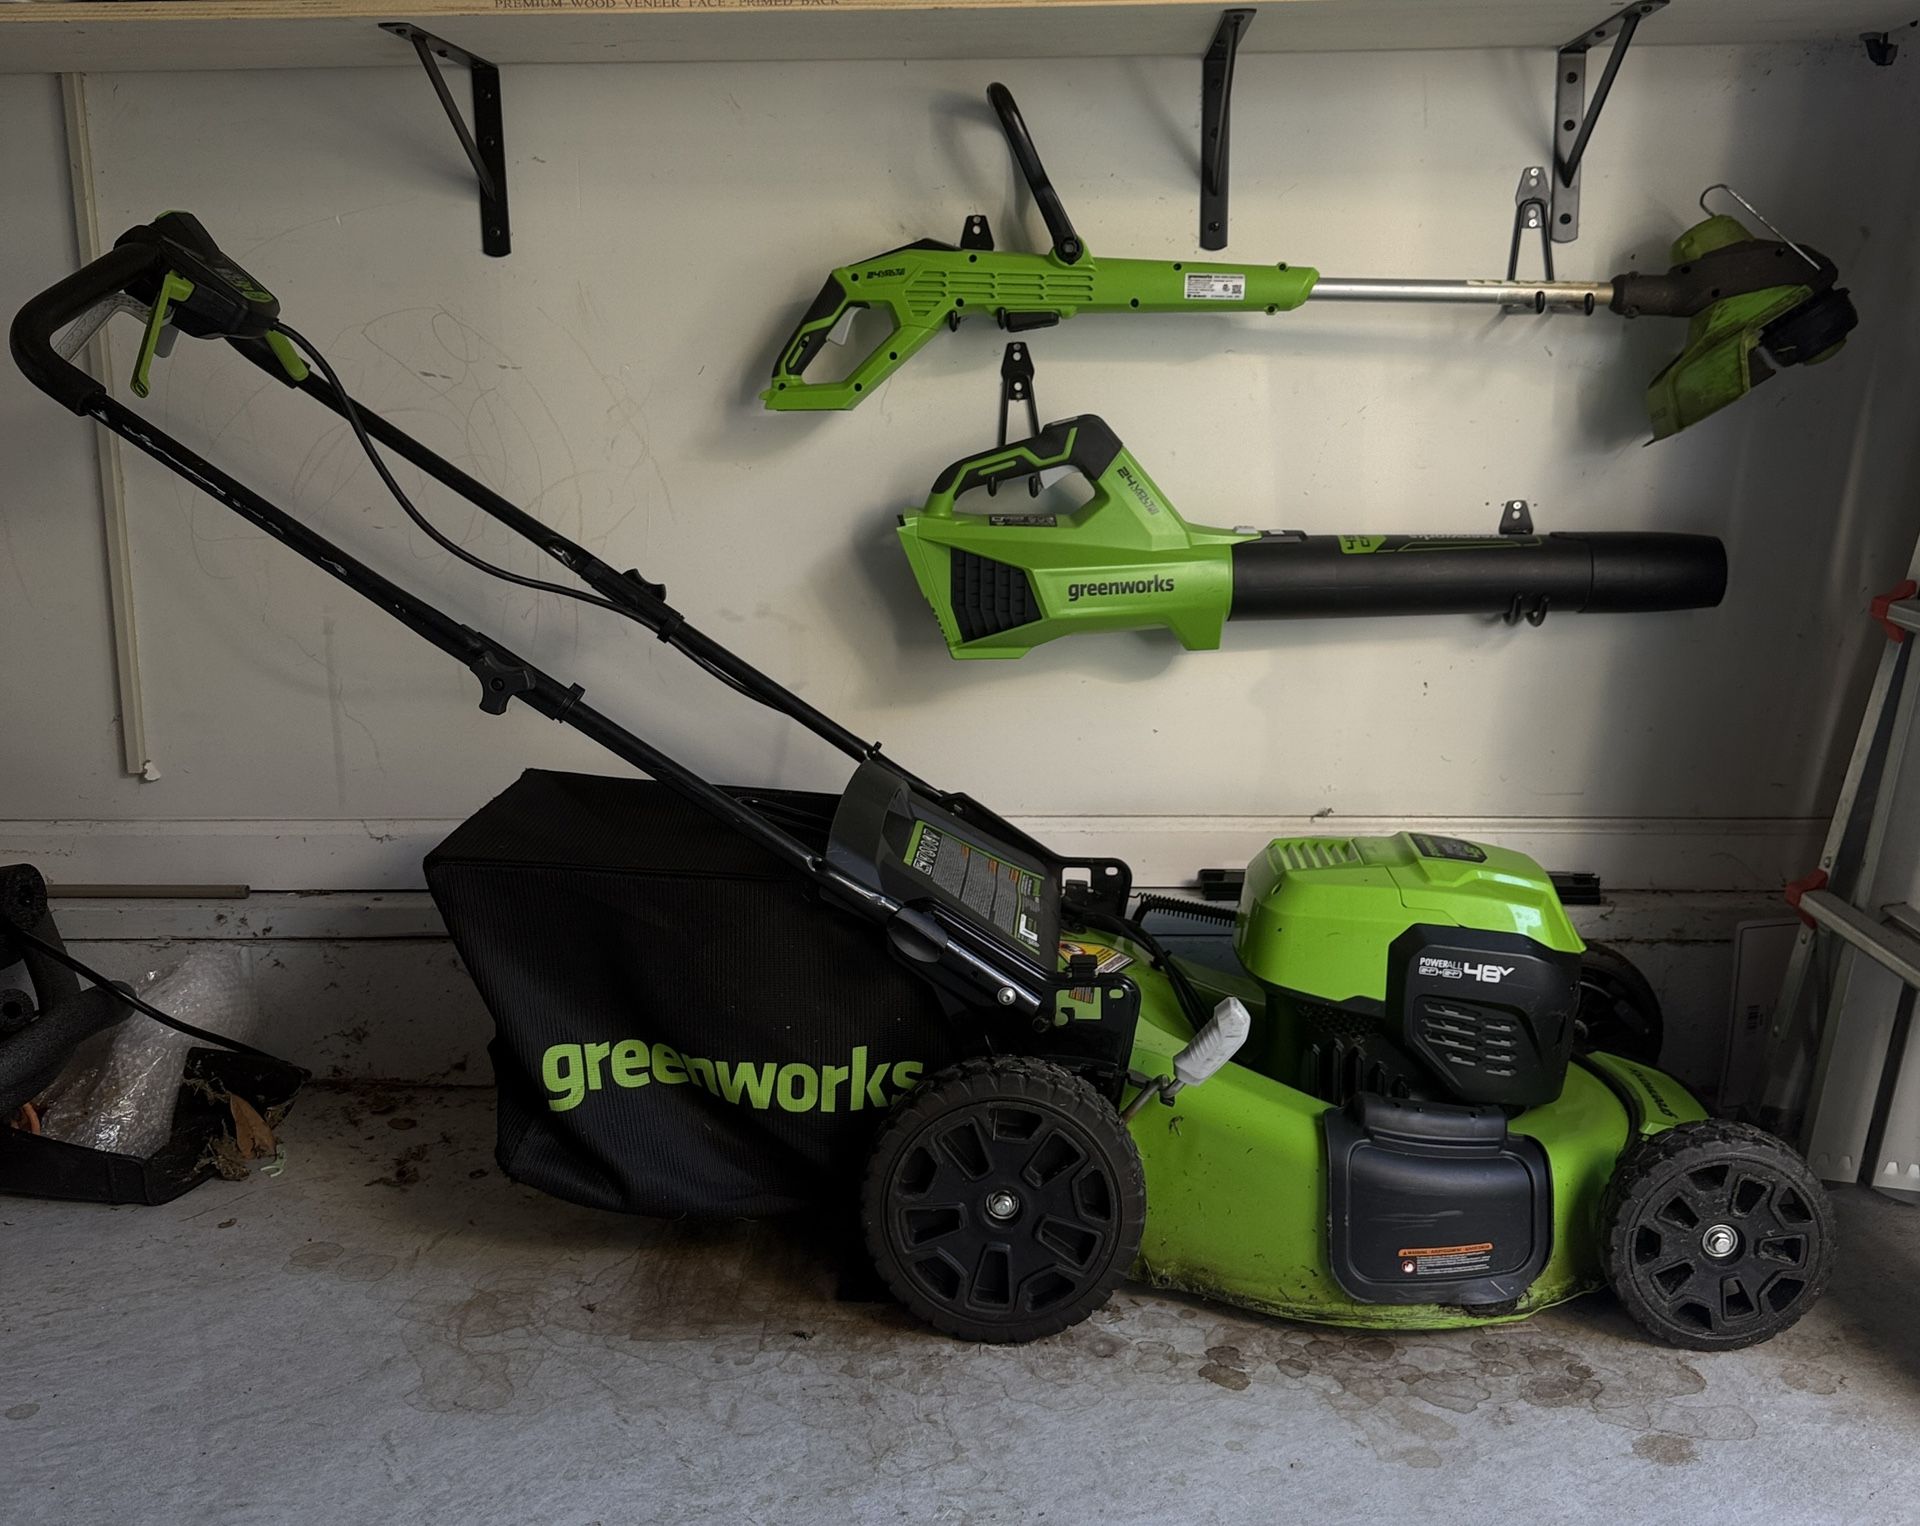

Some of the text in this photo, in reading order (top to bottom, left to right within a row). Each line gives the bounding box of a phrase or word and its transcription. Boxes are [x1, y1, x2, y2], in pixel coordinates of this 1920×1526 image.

[495, 0, 562, 8] PREMIUM
[571, 0, 616, 8] WOOD
[626, 0, 680, 8] VENEER
[1068, 574, 1175, 602] greenworks
[542, 1039, 923, 1112] greenworks
